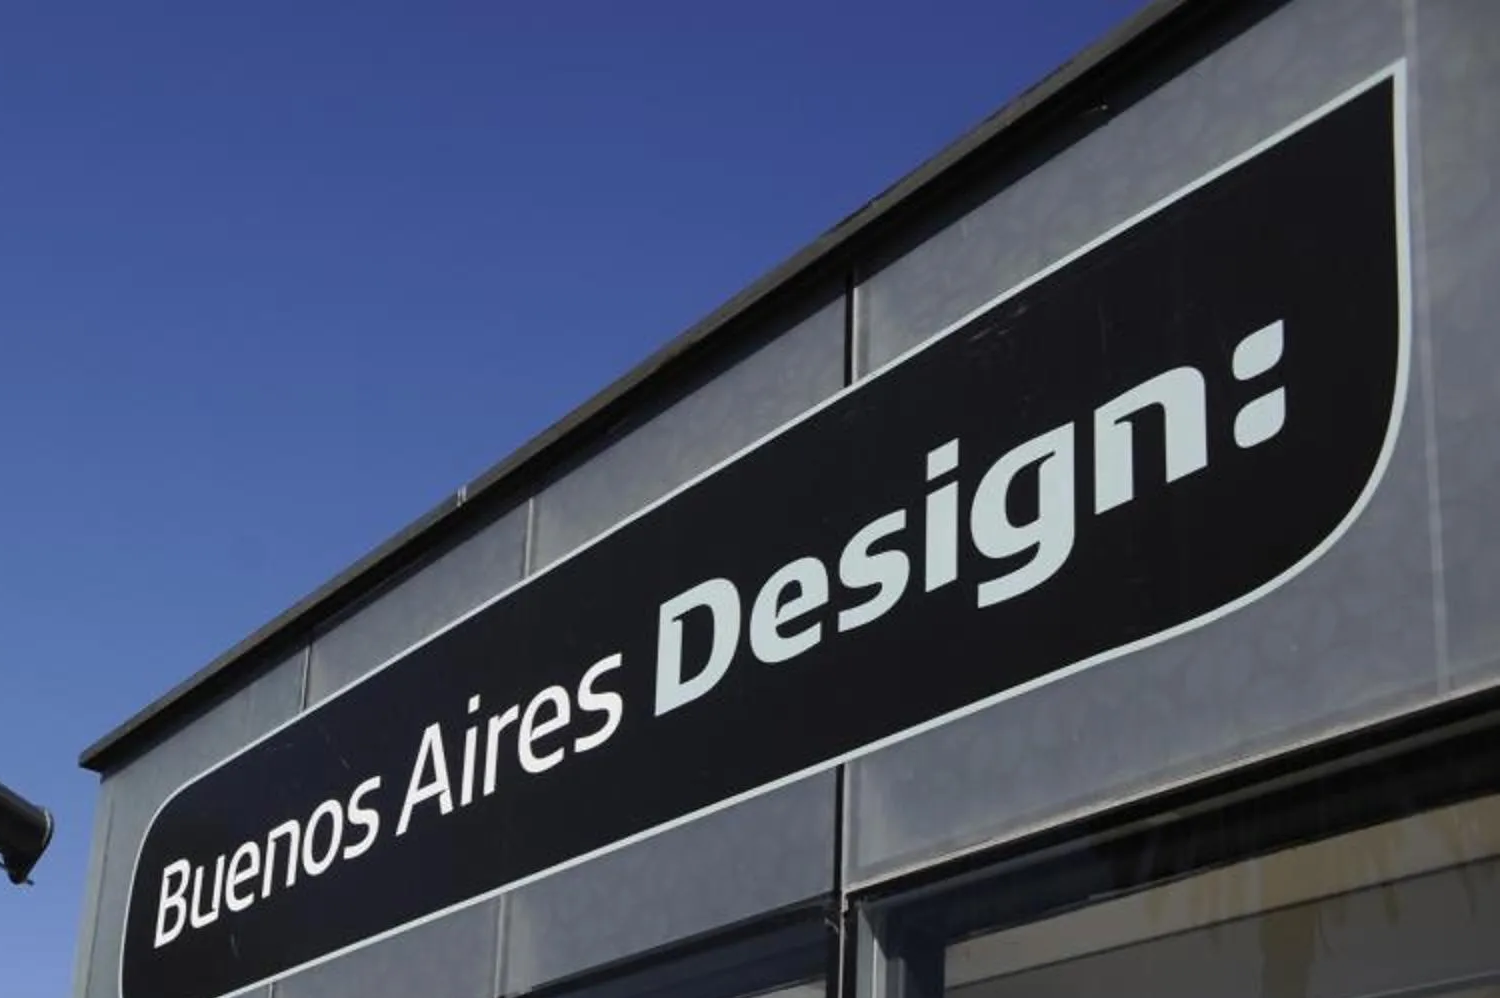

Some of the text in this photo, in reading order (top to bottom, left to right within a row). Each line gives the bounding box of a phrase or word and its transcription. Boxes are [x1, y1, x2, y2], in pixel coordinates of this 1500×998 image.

[153, 319, 1286, 949] Buenos Aires Design:
